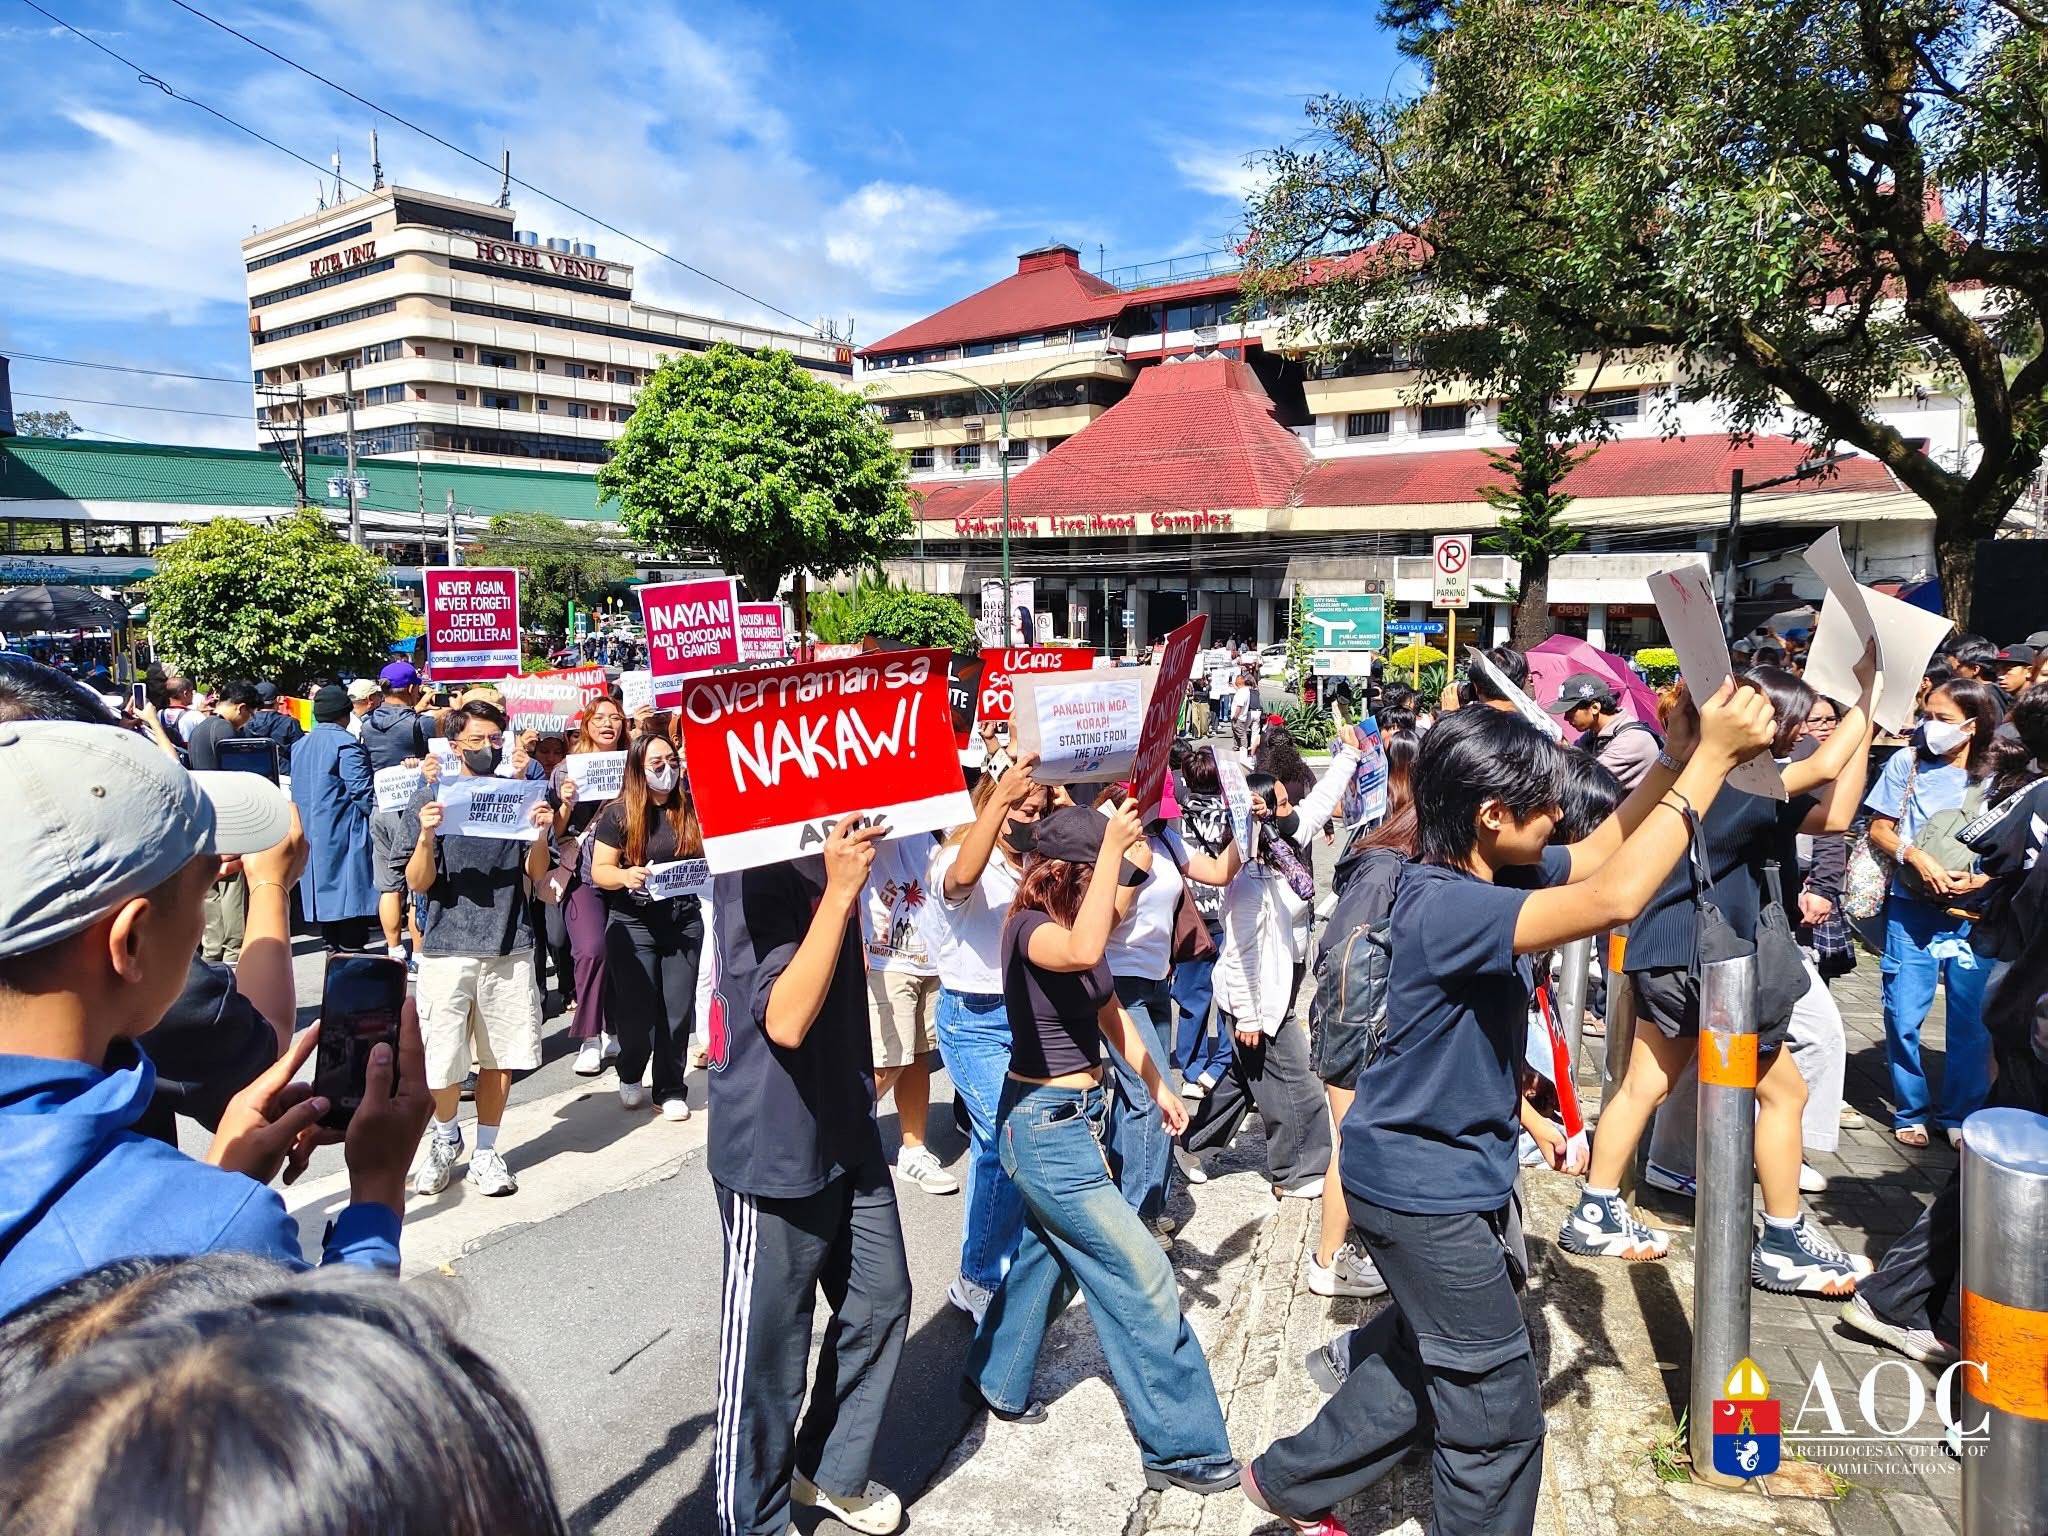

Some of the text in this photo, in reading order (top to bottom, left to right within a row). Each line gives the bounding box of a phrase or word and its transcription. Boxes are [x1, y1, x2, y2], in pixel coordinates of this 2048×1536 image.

[310, 241, 377, 277] HOTEL VENIZ
[476, 241, 608, 282] HOTEL VENIZ
[1151, 507, 1232, 532] Complex
[438, 581, 506, 596] NEVER AGAIN,
[1446, 577, 1457, 585] NO
[1436, 588, 1466, 599] PARKING
[434, 597, 468, 611] NEVER
[450, 613, 496, 628] DEFEND
[649, 599, 730, 631] INAYAN!
[436, 628, 511, 643] CORDILLERA!
[652, 626, 732, 649] ADI BOKODAN
[493, 653, 519, 662] ALLIANCE
[666, 641, 721, 661] DI GAWIS!
[654, 679, 683, 689] CORDILLE
[1052, 699, 1128, 717] PANAGUTIN MGA
[1076, 714, 1110, 731] KORAP!
[726, 690, 923, 793] NAKAW!
[1059, 729, 1127, 747] STARTING FROM
[1074, 745, 1112, 760] THE TOP!
[588, 760, 605, 769] SHUT
[587, 776, 606, 786] LIGHT
[607, 775, 617, 784] UP
[471, 792, 524, 804] YOUR VOICE
[470, 803, 516, 815] MATTERS,
[468, 812, 517, 825] SPEAK UP!
[655, 874, 670, 884] DIM
[672, 873, 685, 883] THE
[664, 879, 706, 891] CORRUPTION
